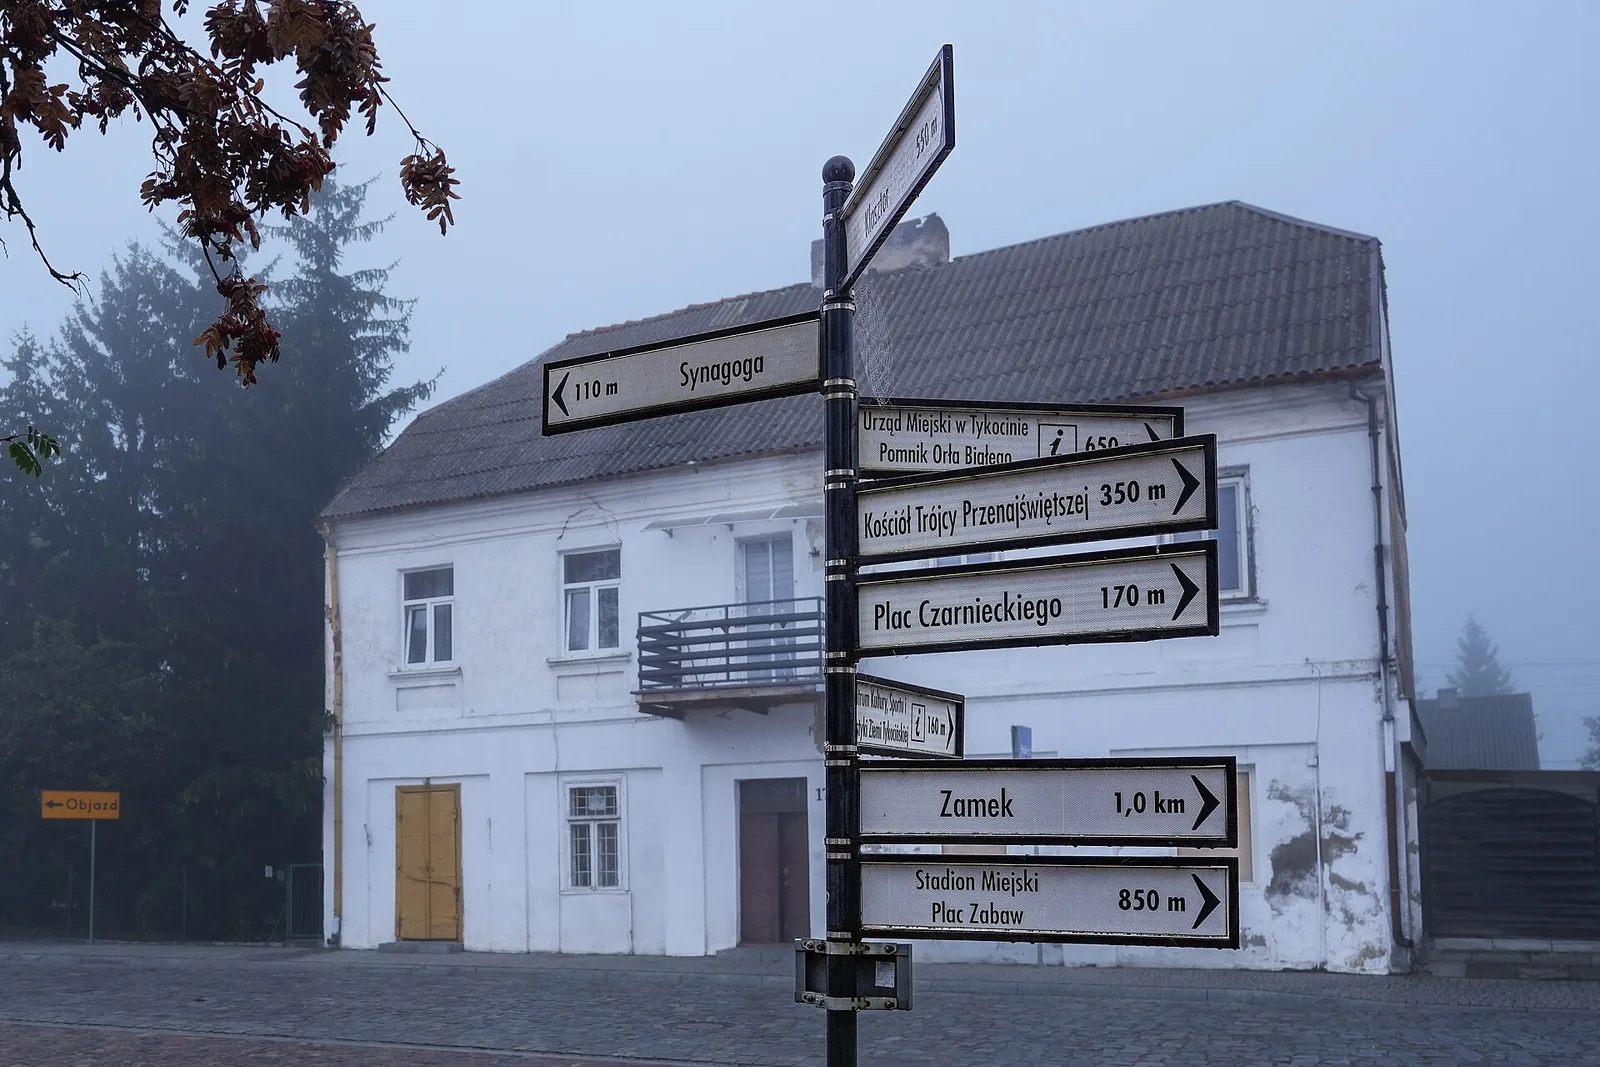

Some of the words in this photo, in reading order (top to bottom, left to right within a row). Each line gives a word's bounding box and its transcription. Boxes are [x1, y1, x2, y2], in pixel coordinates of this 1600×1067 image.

[864, 187, 889, 238] Klasztor
[916, 122, 930, 160] 550
[574, 379, 601, 402] 110
[606, 380, 618, 396] m
[679, 355, 764, 391] Synagoga
[863, 411, 901, 437] Urząd
[906, 411, 951, 438] Miejski
[956, 419, 966, 434] w
[970, 413, 1029, 439] Tykocinie
[880, 441, 928, 464] Pomnik
[932, 442, 960, 465] Orła
[864, 505, 911, 539] Kościół
[915, 505, 957, 537] Trójcy
[962, 485, 1090, 529] Przenajświętszej
[1100, 480, 1140, 507] 350
[1148, 482, 1166, 501] m
[874, 599, 911, 631] Plac
[918, 591, 1062, 627] Czarnieckiego
[1100, 584, 1139, 609] 170
[1147, 587, 1165, 605] m
[927, 715, 939, 735] 160
[940, 723, 946, 736] m
[66, 798, 117, 814] Objazd
[939, 788, 1014, 818] Zamek
[1114, 791, 1146, 818] 1,0
[1154, 790, 1185, 814] km
[915, 869, 975, 892] Stadion
[981, 869, 1039, 897] Miejski
[931, 902, 966, 925] Plac
[970, 903, 1023, 925] Zabaw
[1118, 888, 1160, 912] 850
[1167, 894, 1186, 912] m
